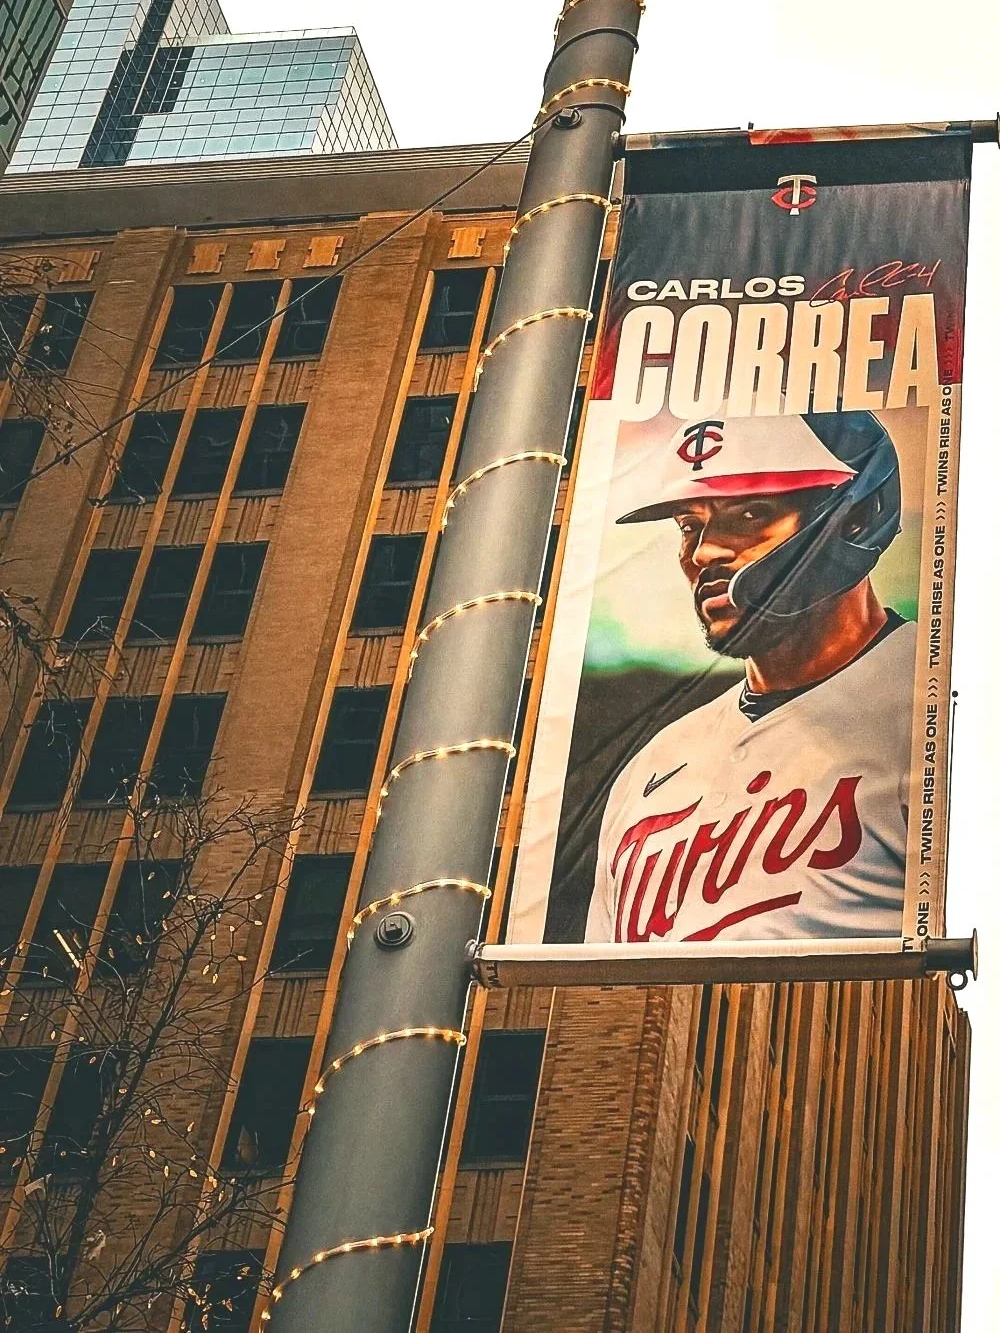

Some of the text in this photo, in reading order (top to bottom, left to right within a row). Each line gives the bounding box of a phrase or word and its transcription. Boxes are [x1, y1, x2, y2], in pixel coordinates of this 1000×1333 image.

[626, 274, 805, 301] CARLOS
[611, 293, 939, 422] CORREA
[942, 368, 953, 396] ONE
[941, 397, 952, 416] AS
[939, 418, 951, 449] RISE
[936, 450, 949, 497] TWINS
[934, 525, 946, 557] ONE
[933, 558, 945, 579] AS
[931, 581, 943, 616] RISE
[929, 617, 942, 669] TWINS
[925, 703, 938, 738] ONE
[924, 740, 937, 764] AS
[922, 766, 935, 805] RISE
[920, 807, 934, 865] TWINS
[610, 770, 863, 943] Twins
[916, 901, 930, 937] ONE
